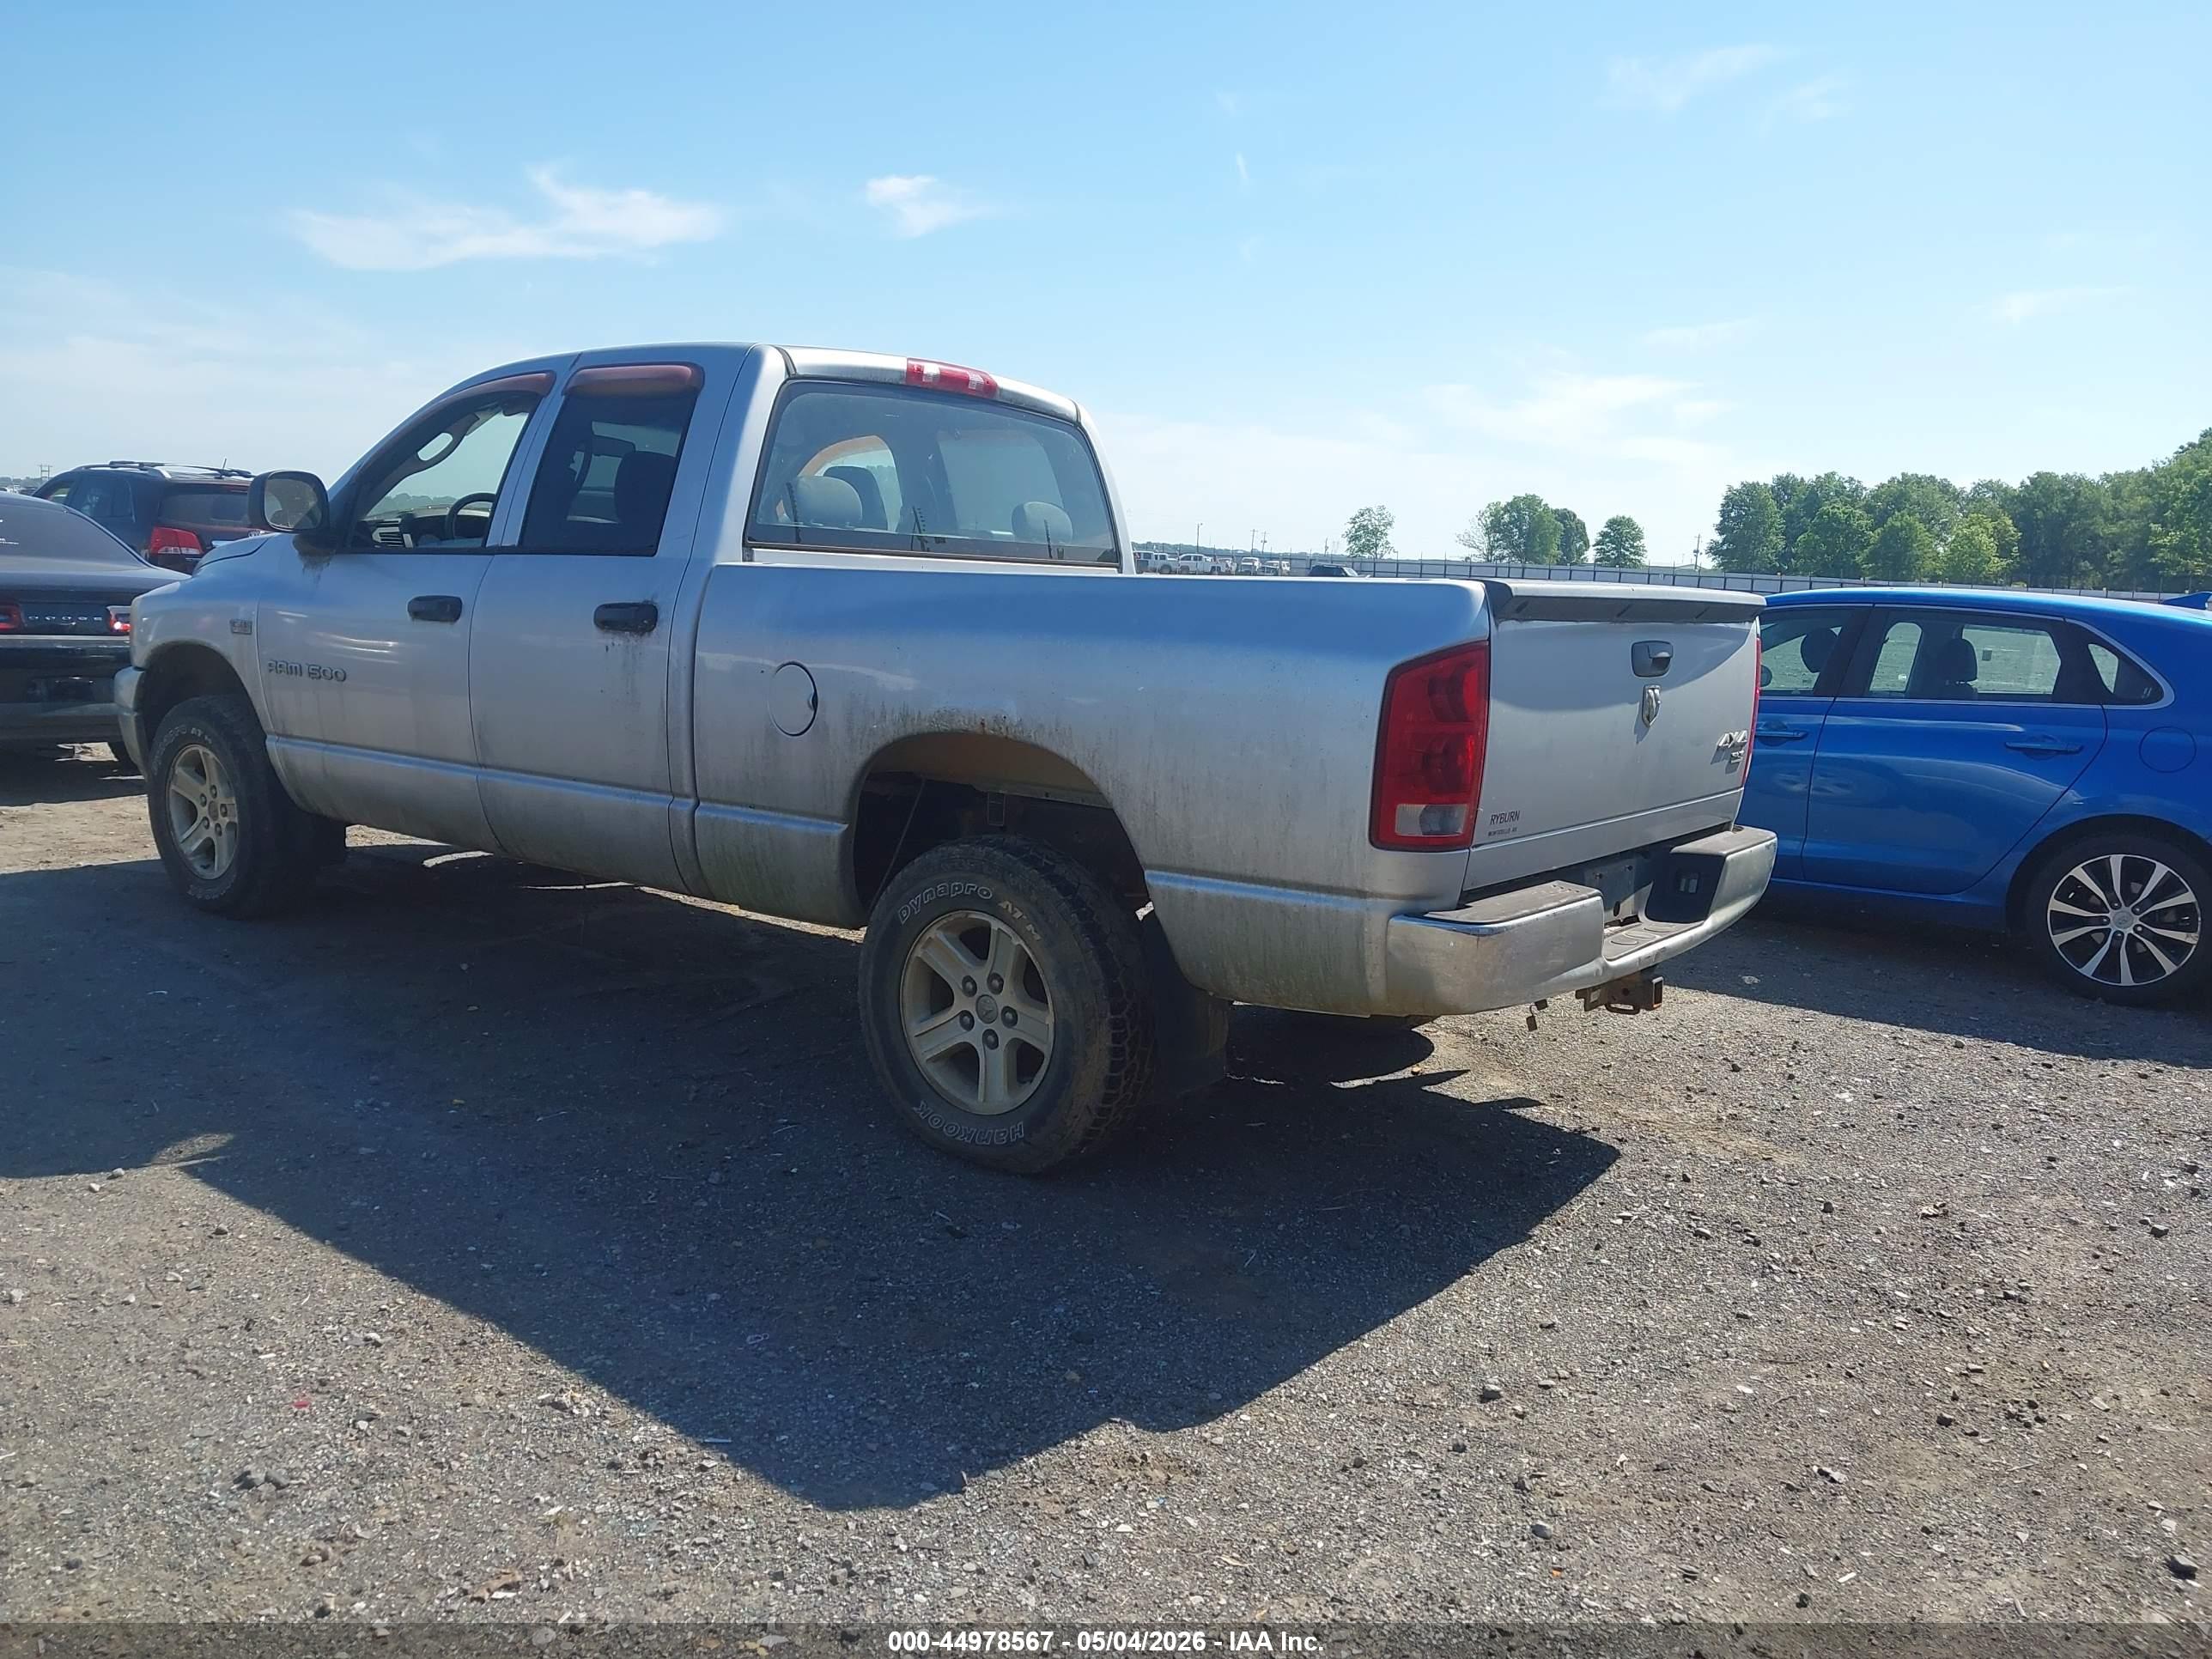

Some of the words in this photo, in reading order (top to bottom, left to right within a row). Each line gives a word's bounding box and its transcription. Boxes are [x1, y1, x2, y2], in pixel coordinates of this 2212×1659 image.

[267, 659, 303, 677] RAM
[306, 662, 347, 683] 1500
[1490, 810, 1520, 825] RYBURN
[898, 882, 993, 925] Dynapro
